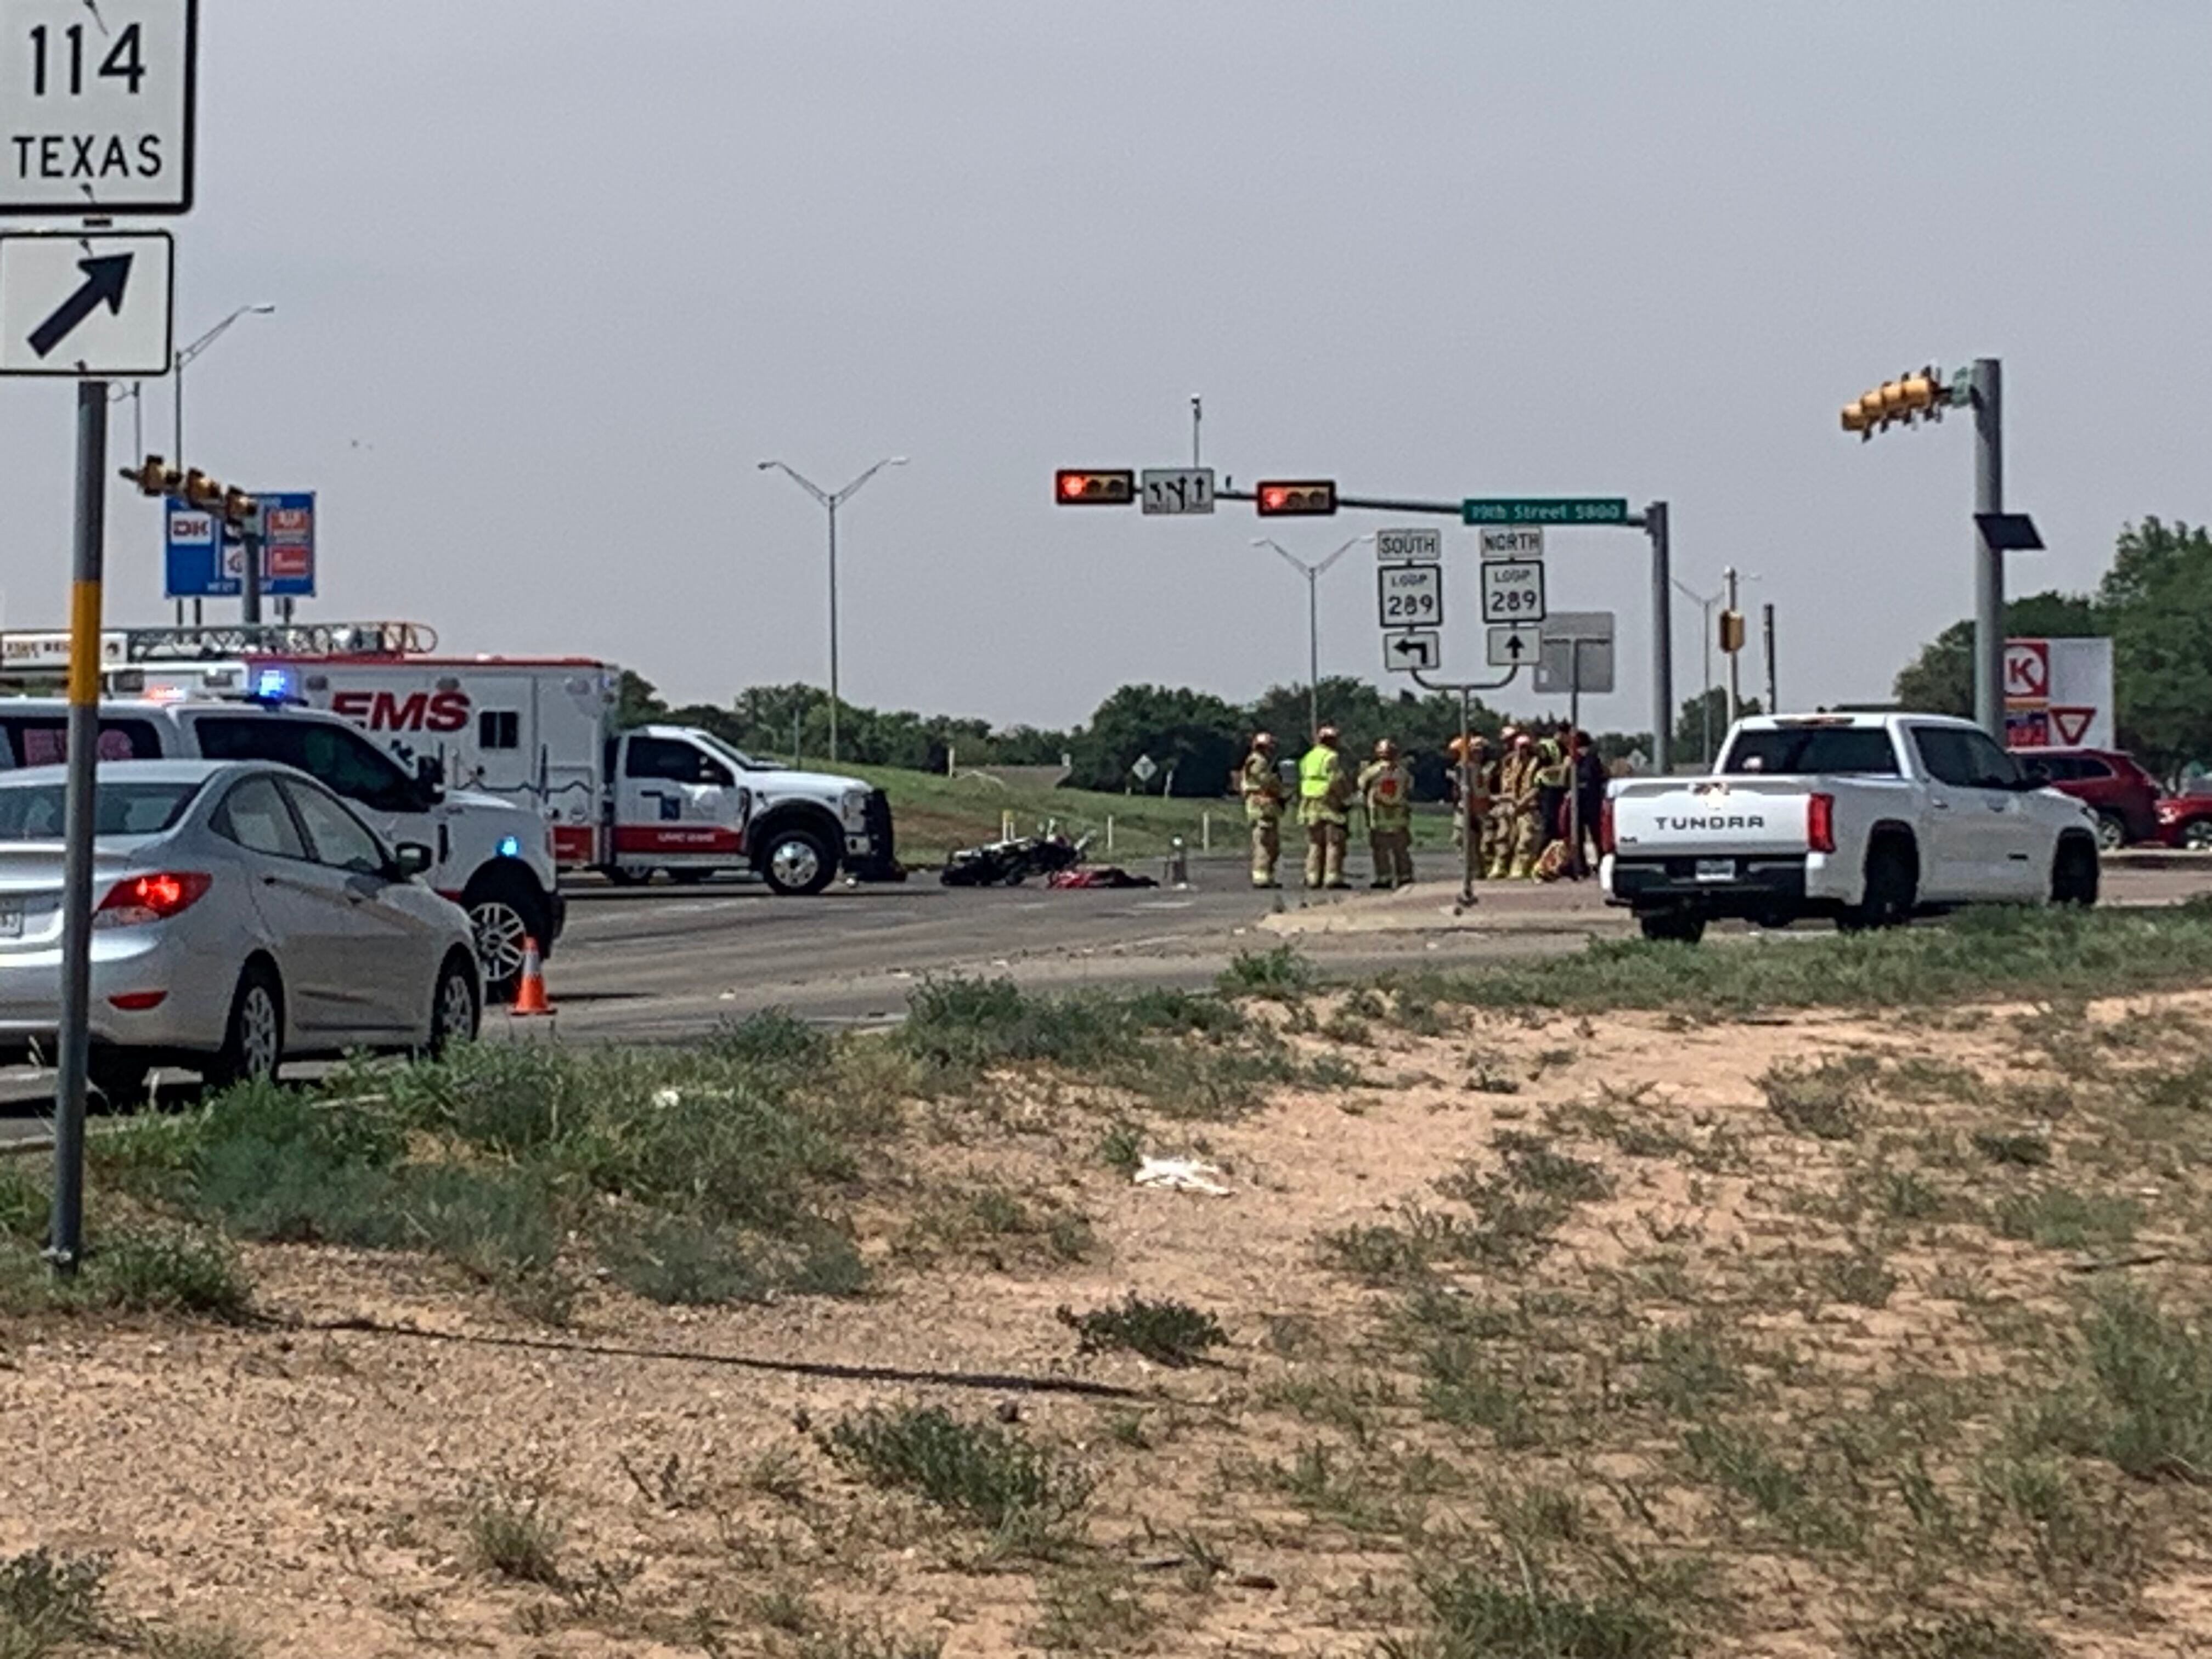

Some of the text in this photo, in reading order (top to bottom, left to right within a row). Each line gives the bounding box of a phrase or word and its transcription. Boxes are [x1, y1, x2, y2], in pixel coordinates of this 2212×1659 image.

[29, 22, 146, 96] 114
[12, 134, 162, 178] TEXAS
[1514, 504, 1567, 519] Street
[172, 520, 208, 537] DK
[1381, 537, 1435, 554] SOUTH
[1484, 533, 1540, 551] NORTH
[1391, 573, 1427, 588] LOOP
[1494, 569, 1531, 583] LOOP
[1387, 594, 1434, 616] 289
[1490, 590, 1537, 612] 289
[2009, 658, 2037, 686] K
[332, 691, 471, 732] EMS
[1654, 816, 1765, 830] TUNDRA
